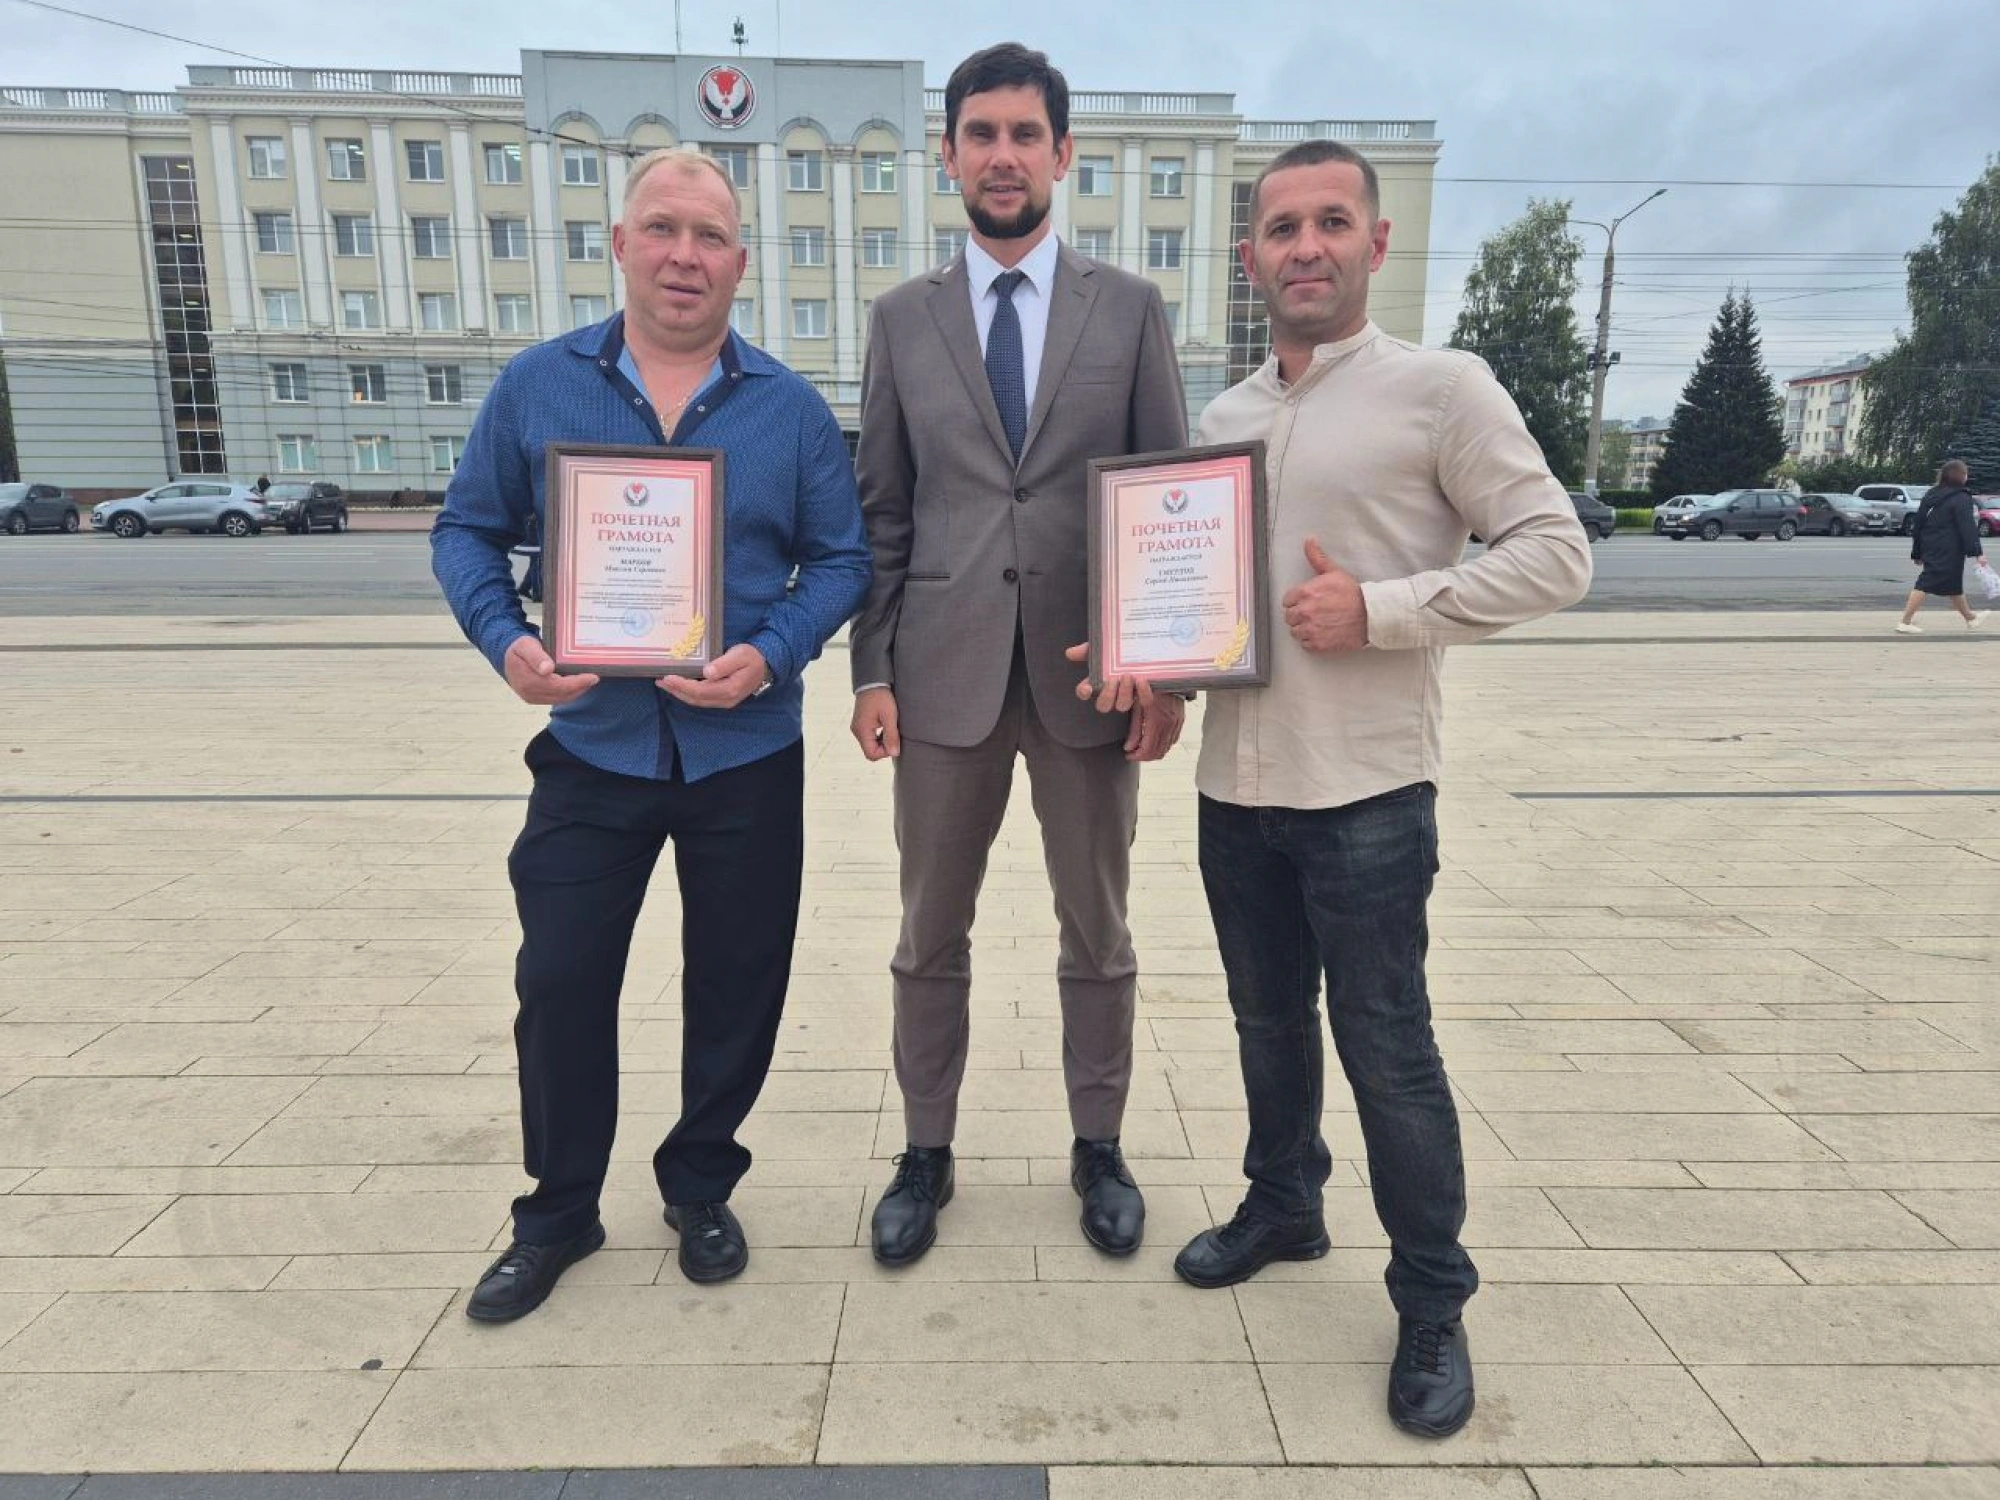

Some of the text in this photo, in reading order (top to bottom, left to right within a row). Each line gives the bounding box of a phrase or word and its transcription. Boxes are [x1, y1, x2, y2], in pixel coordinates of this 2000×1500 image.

[590, 512, 682, 527] ПОЧЕТНАЯ
[1131, 517, 1221, 536] ПОЧЕТНАЯ
[597, 529, 675, 543] ГРАМОТА
[1137, 536, 1214, 553] ГРАМОТА
